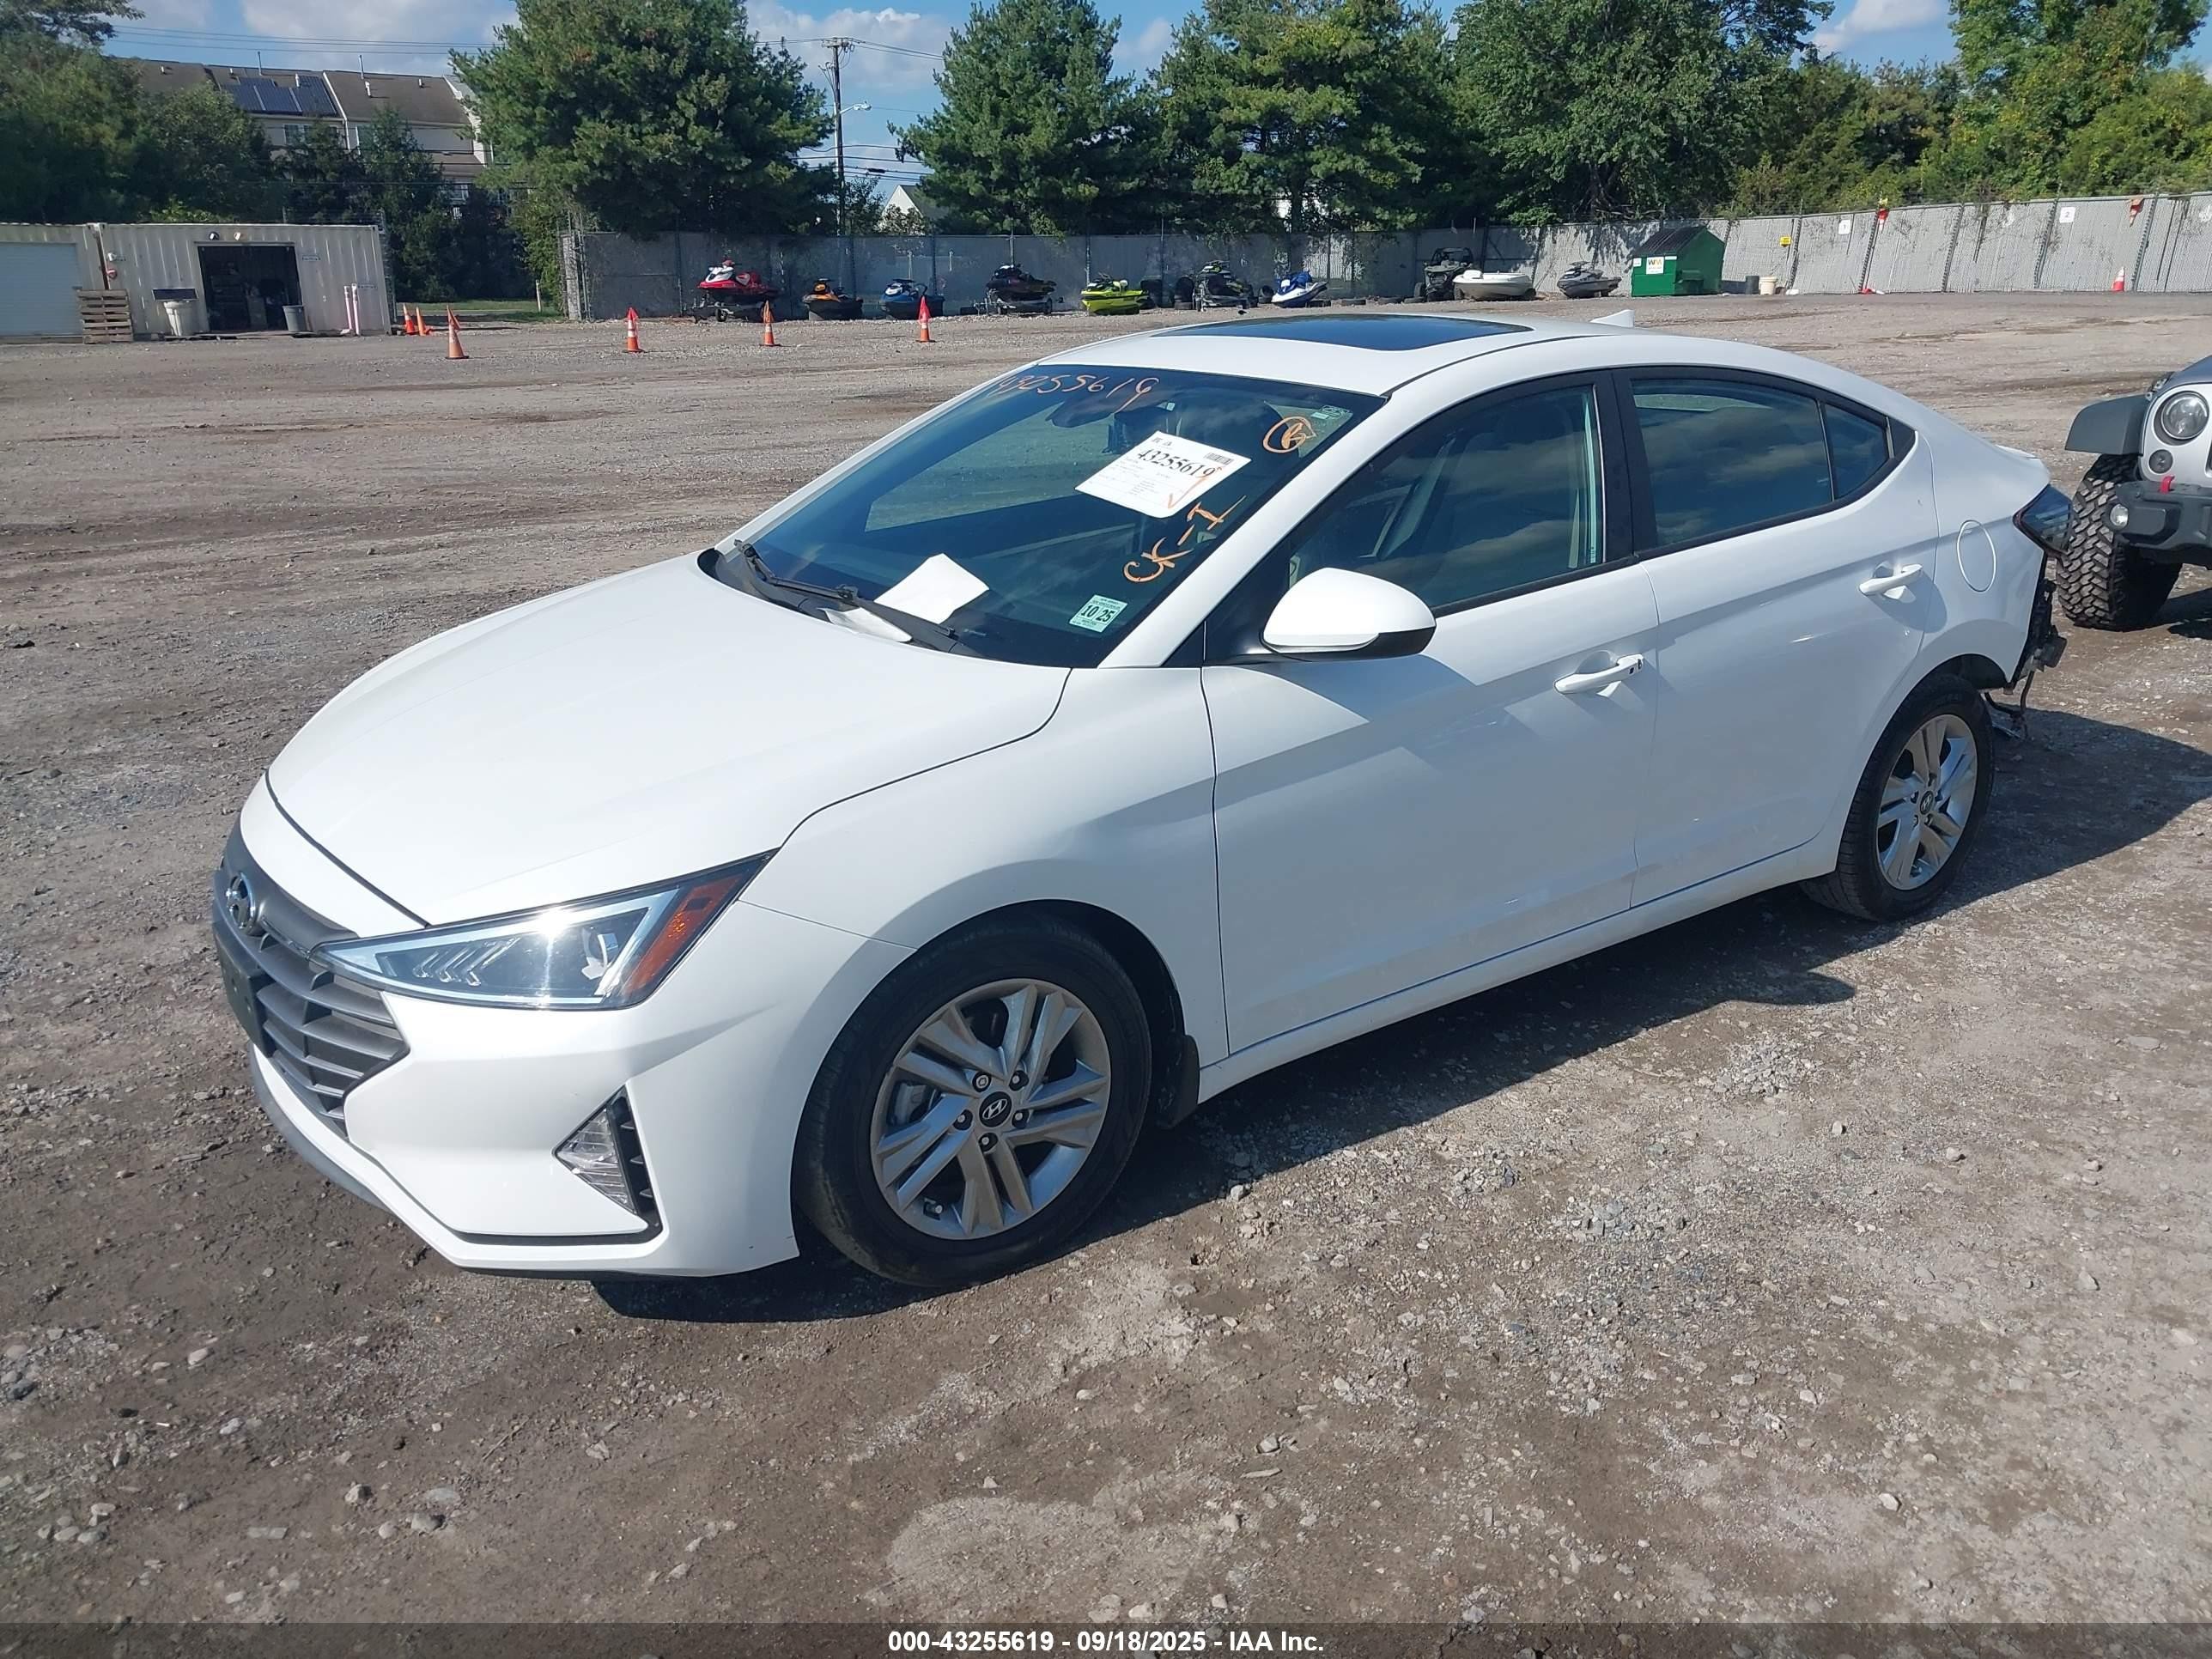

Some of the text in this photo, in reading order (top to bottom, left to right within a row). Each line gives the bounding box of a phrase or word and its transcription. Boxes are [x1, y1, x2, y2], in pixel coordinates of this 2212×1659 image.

[1137, 447, 1216, 478] 43255619
[1080, 604, 1100, 618] 10
[1095, 609, 1116, 623] 25
